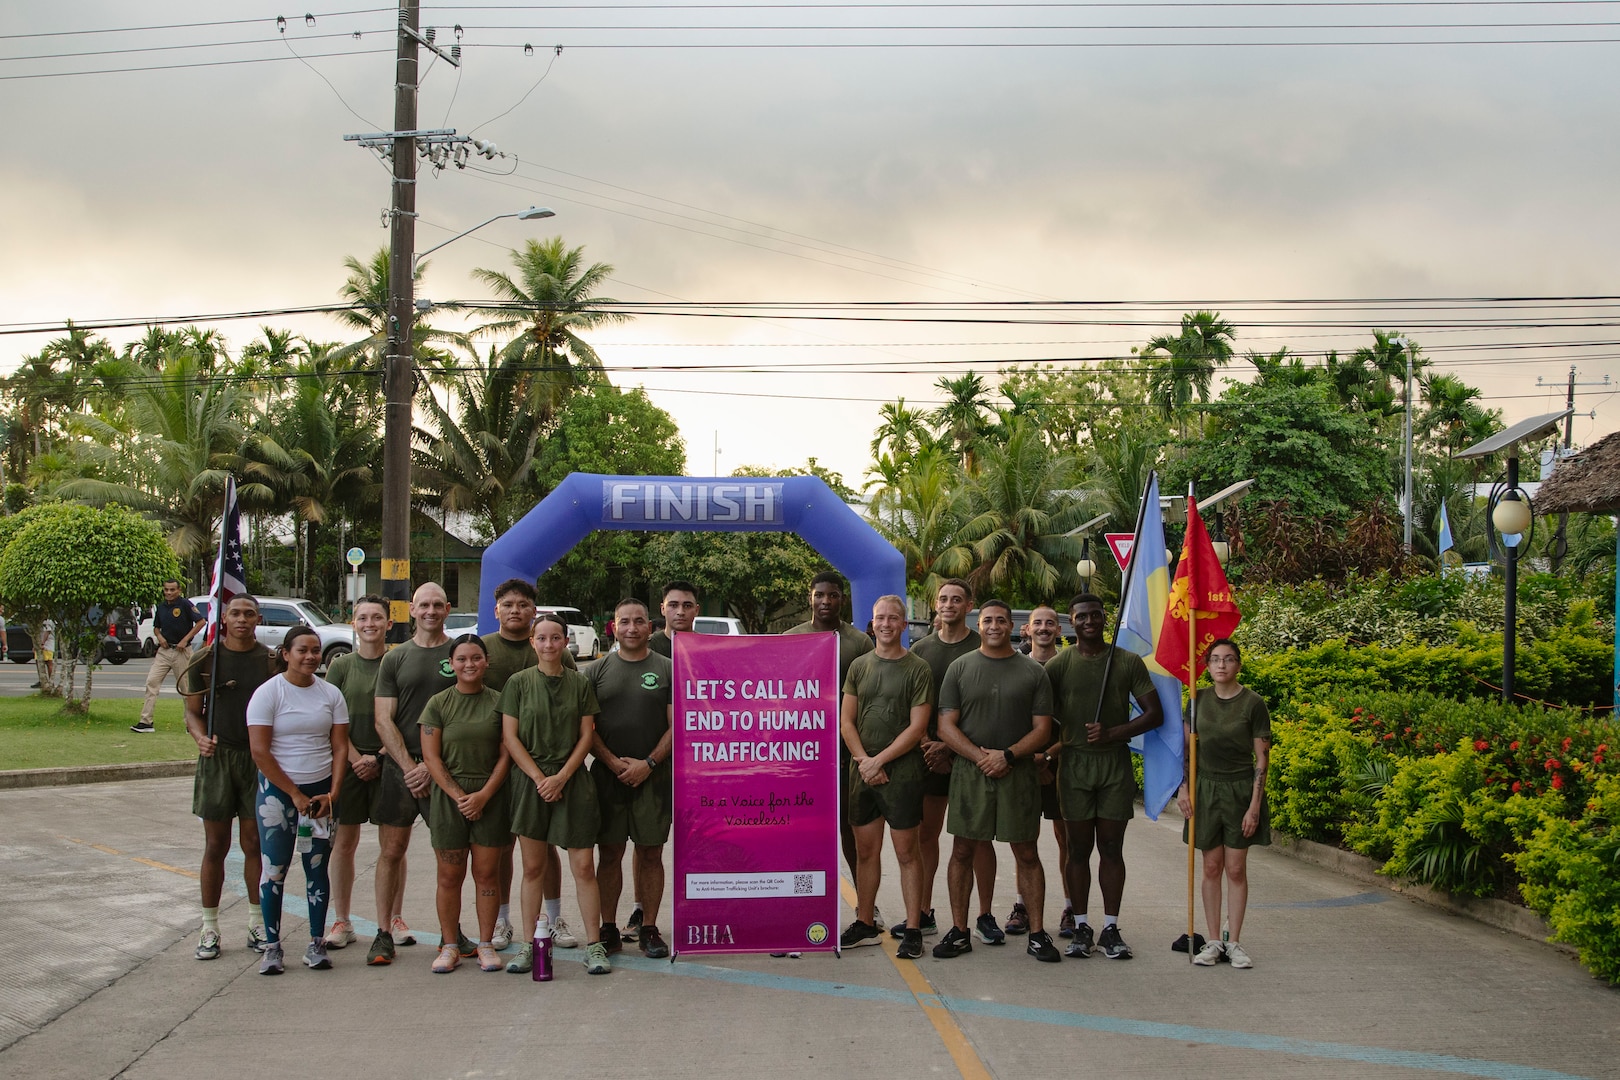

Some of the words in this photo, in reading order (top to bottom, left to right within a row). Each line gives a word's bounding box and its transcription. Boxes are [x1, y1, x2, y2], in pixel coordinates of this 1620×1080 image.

[611, 484, 775, 521] FINISH
[1207, 591, 1224, 602] 1st
[1195, 632, 1215, 656] MLG
[686, 680, 736, 700] LET'S
[740, 680, 788, 700] CALL
[793, 679, 820, 699] AN
[685, 711, 725, 731] END
[729, 711, 754, 731] TO
[759, 710, 826, 730] HUMAN
[691, 741, 820, 762] TRAFFICKING!
[700, 796, 715, 807] Be
[718, 798, 727, 807] a
[731, 795, 765, 807] Voice
[768, 791, 791, 813] for
[793, 791, 814, 806] the
[725, 811, 790, 826] Voiceless!
[481, 889, 496, 897] 222
[687, 924, 735, 945] BHA
